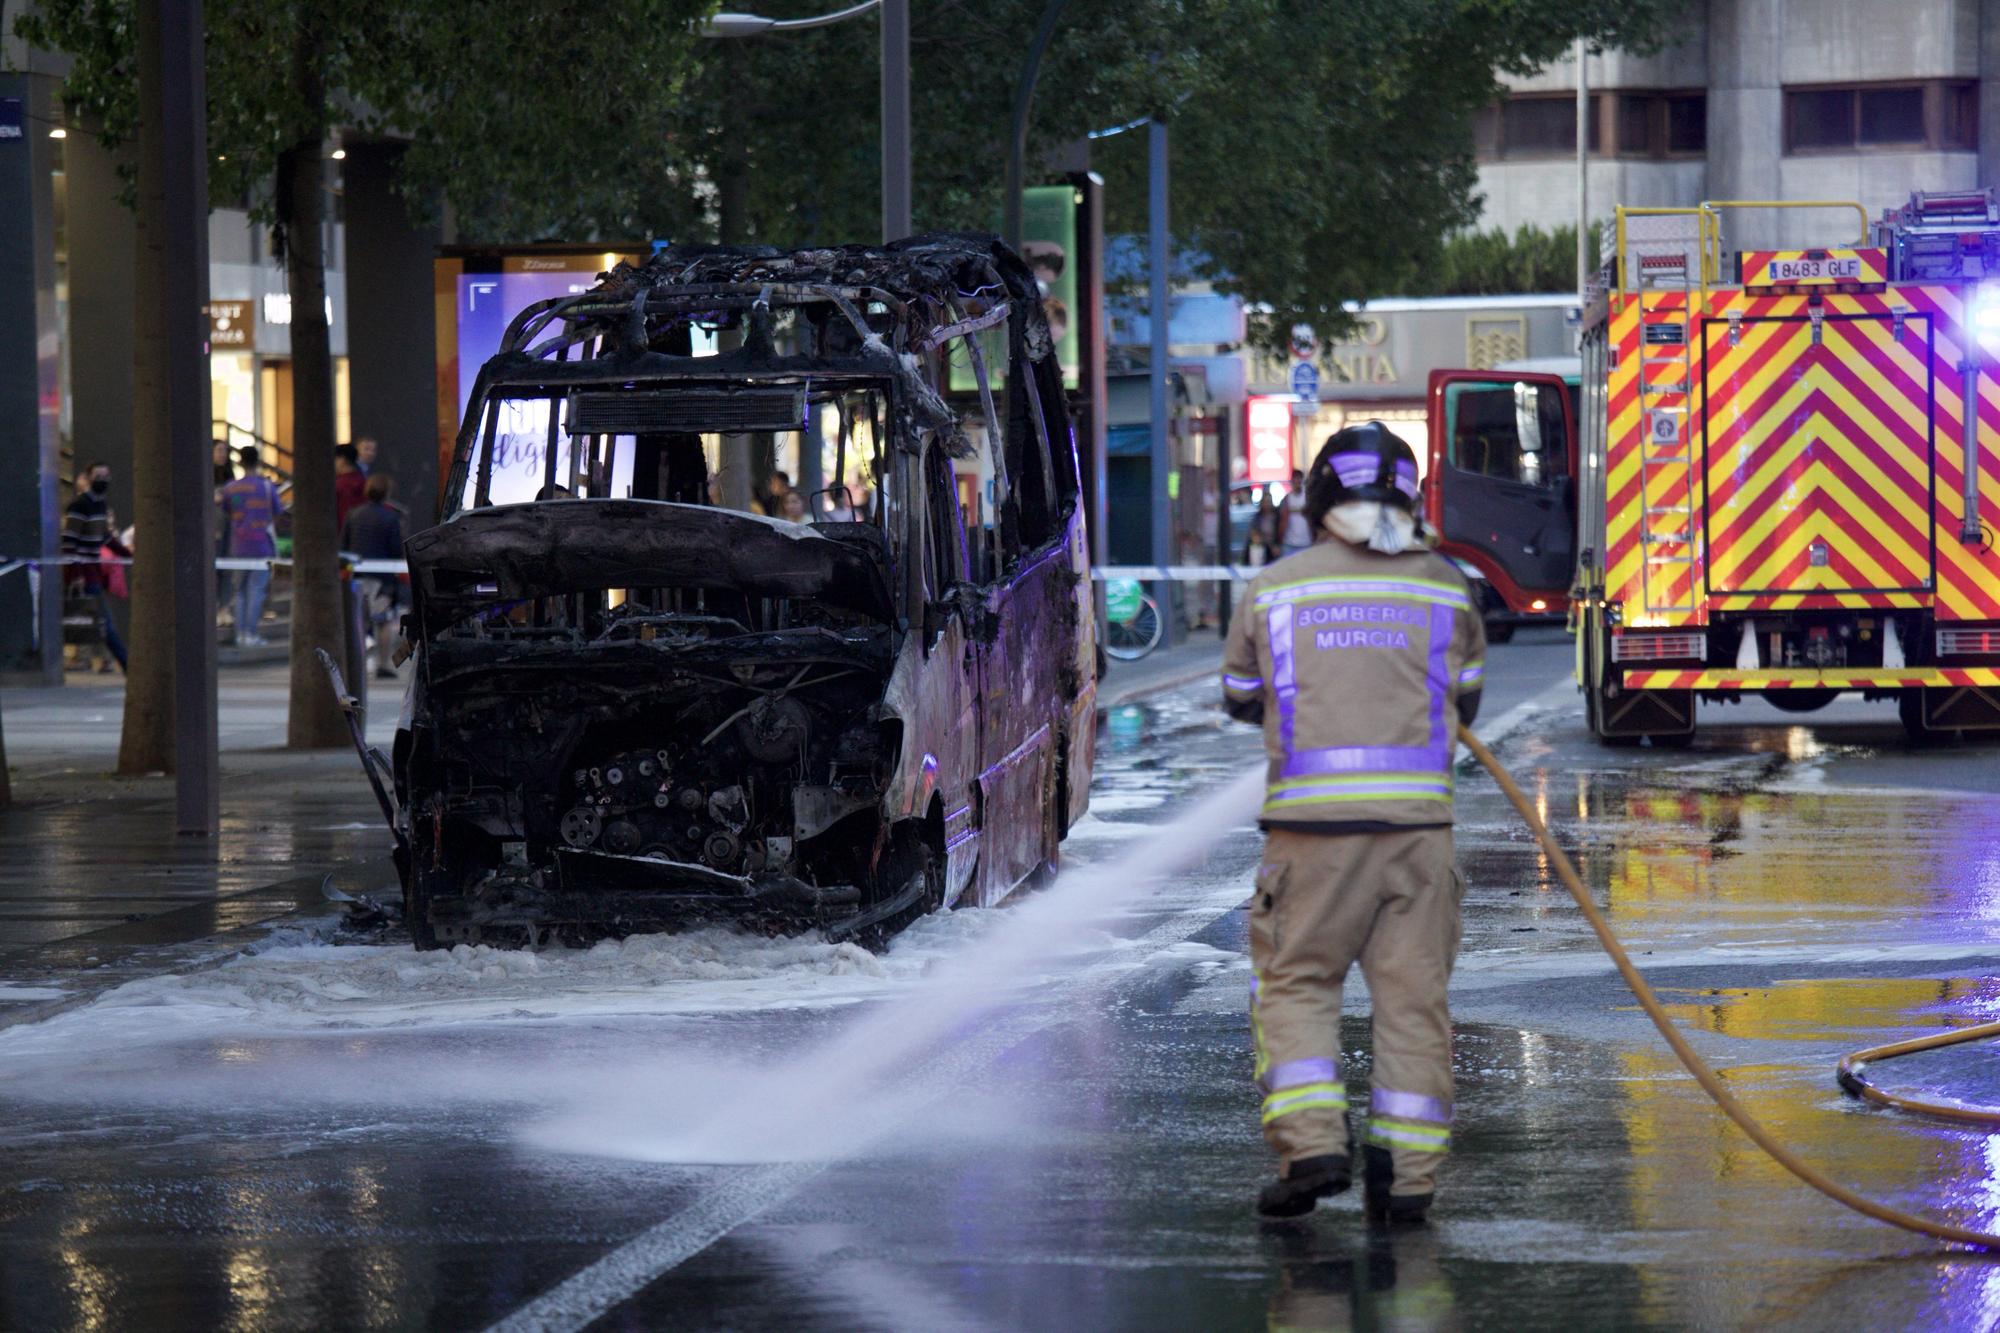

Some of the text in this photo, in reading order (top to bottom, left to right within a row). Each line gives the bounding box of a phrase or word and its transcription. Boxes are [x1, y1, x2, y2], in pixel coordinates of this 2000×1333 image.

[1782, 261, 1857, 277] 8483 GLF
[1316, 630, 1408, 649] MURCIA
